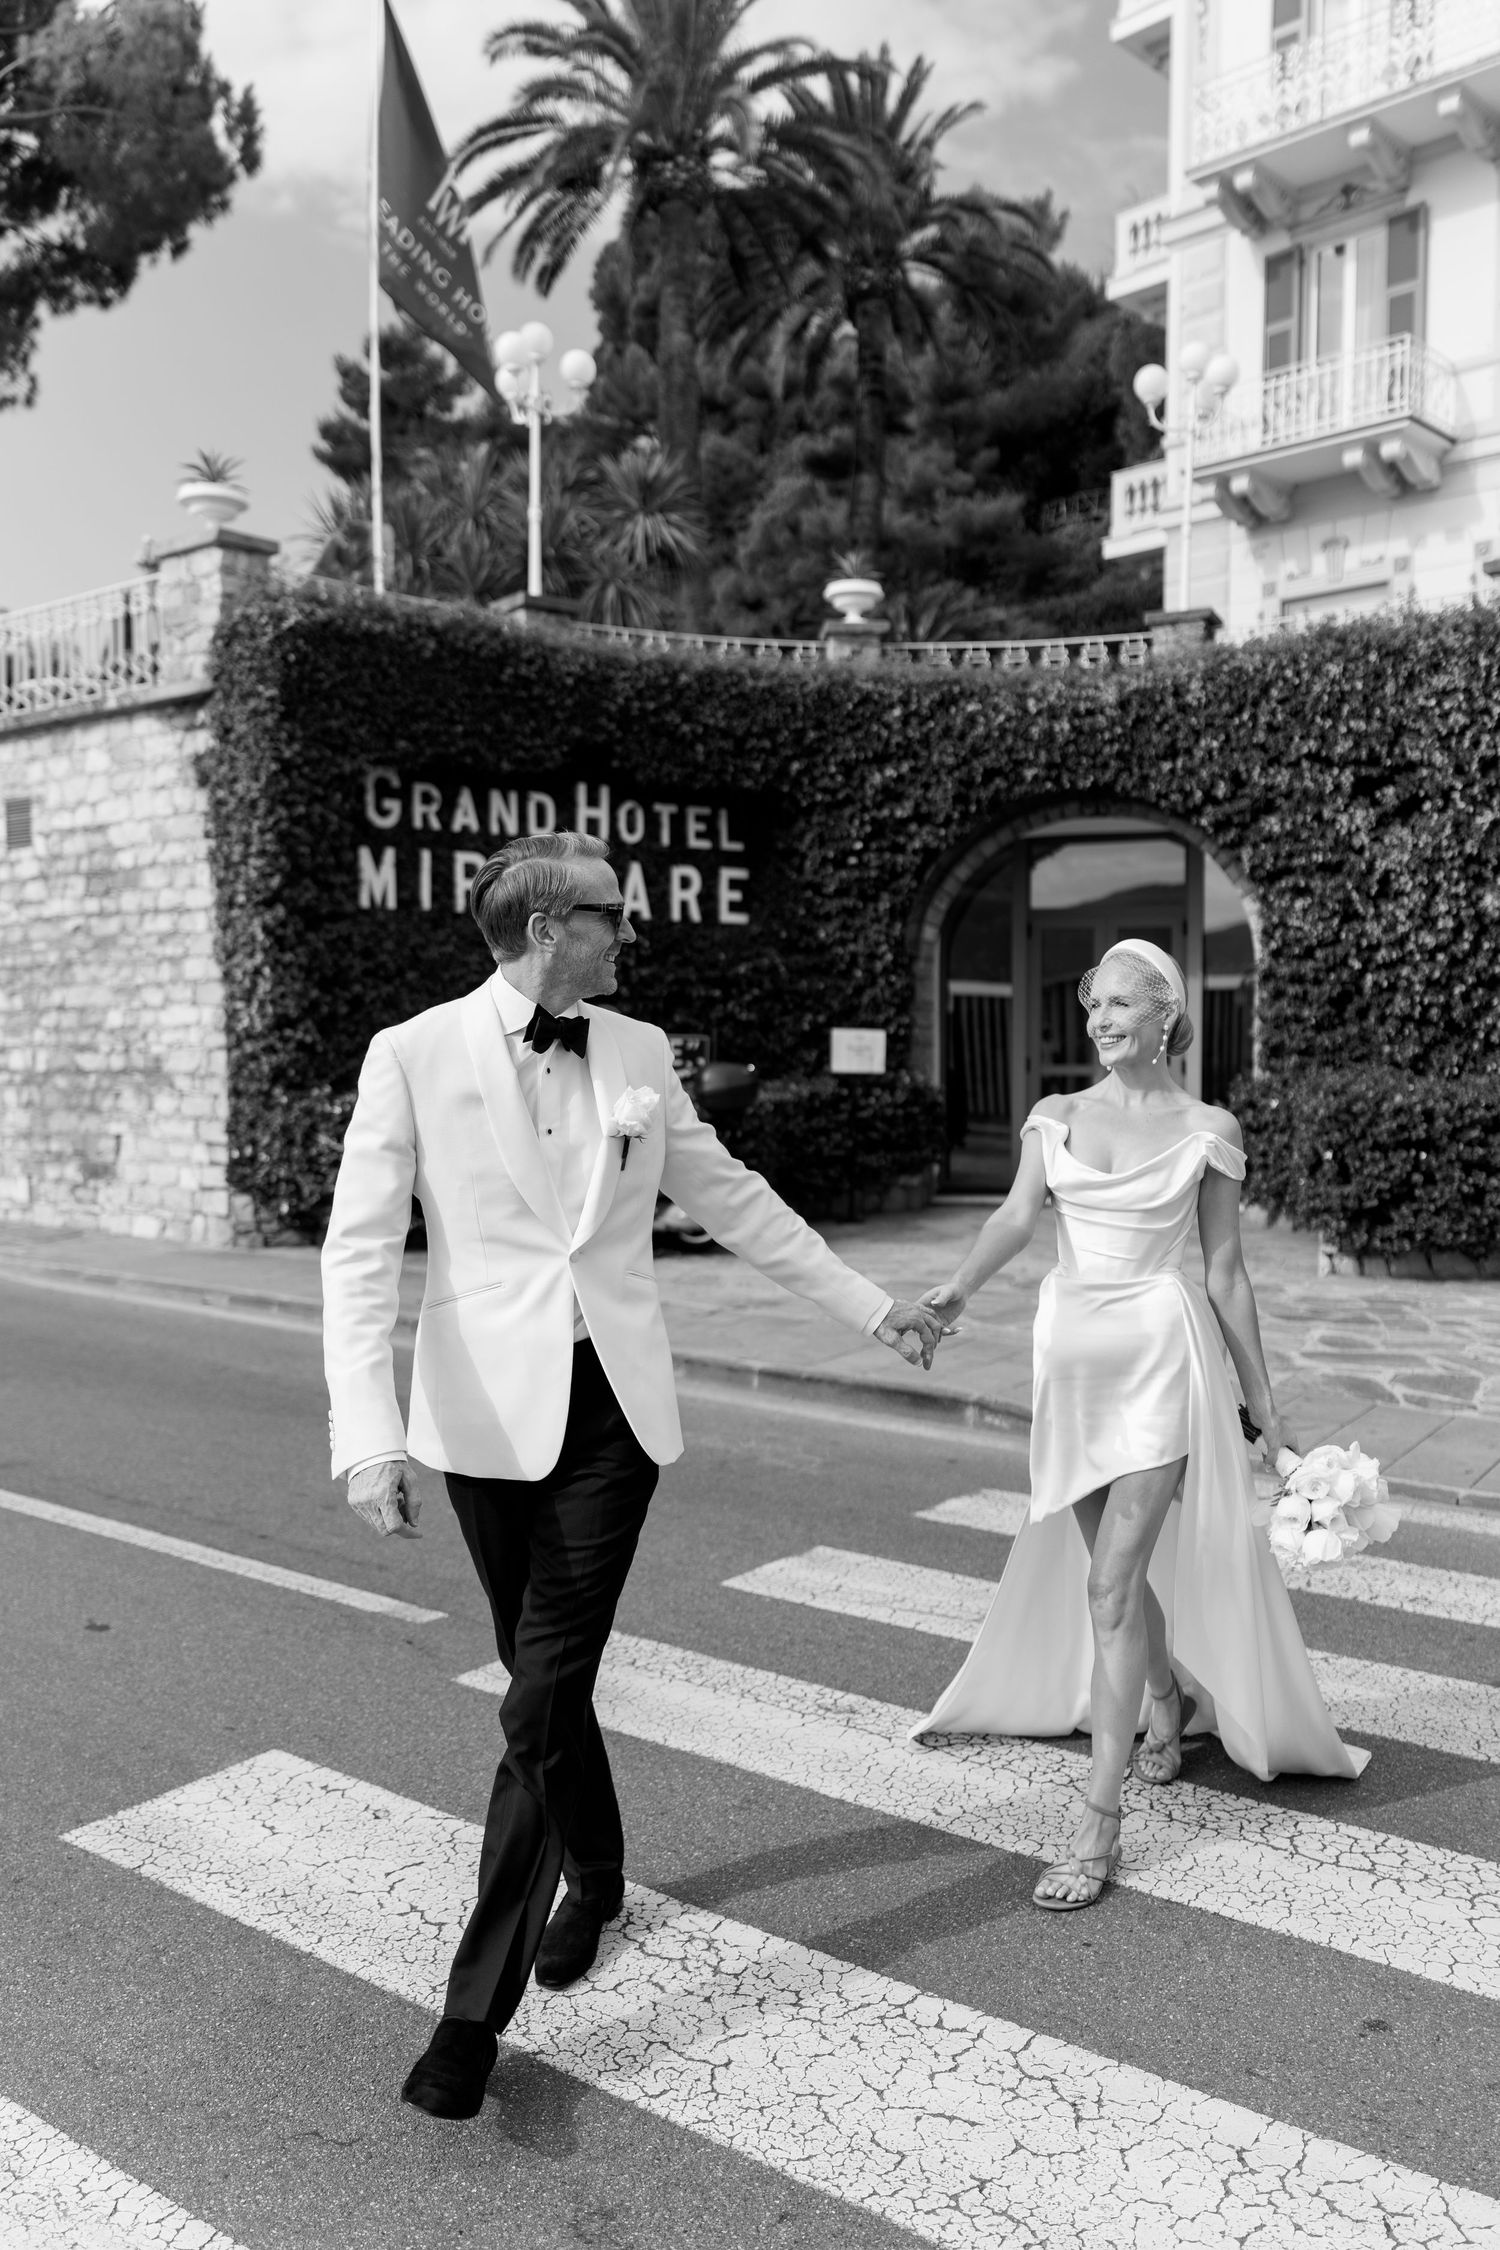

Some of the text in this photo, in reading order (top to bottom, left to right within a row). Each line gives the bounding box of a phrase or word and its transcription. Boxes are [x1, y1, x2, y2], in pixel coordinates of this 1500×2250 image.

[379, 197, 452, 289] EADING
[452, 286, 486, 325] HO
[364, 768, 746, 852] GRAND HOTEL
[357, 845, 750, 924] MIRARE
